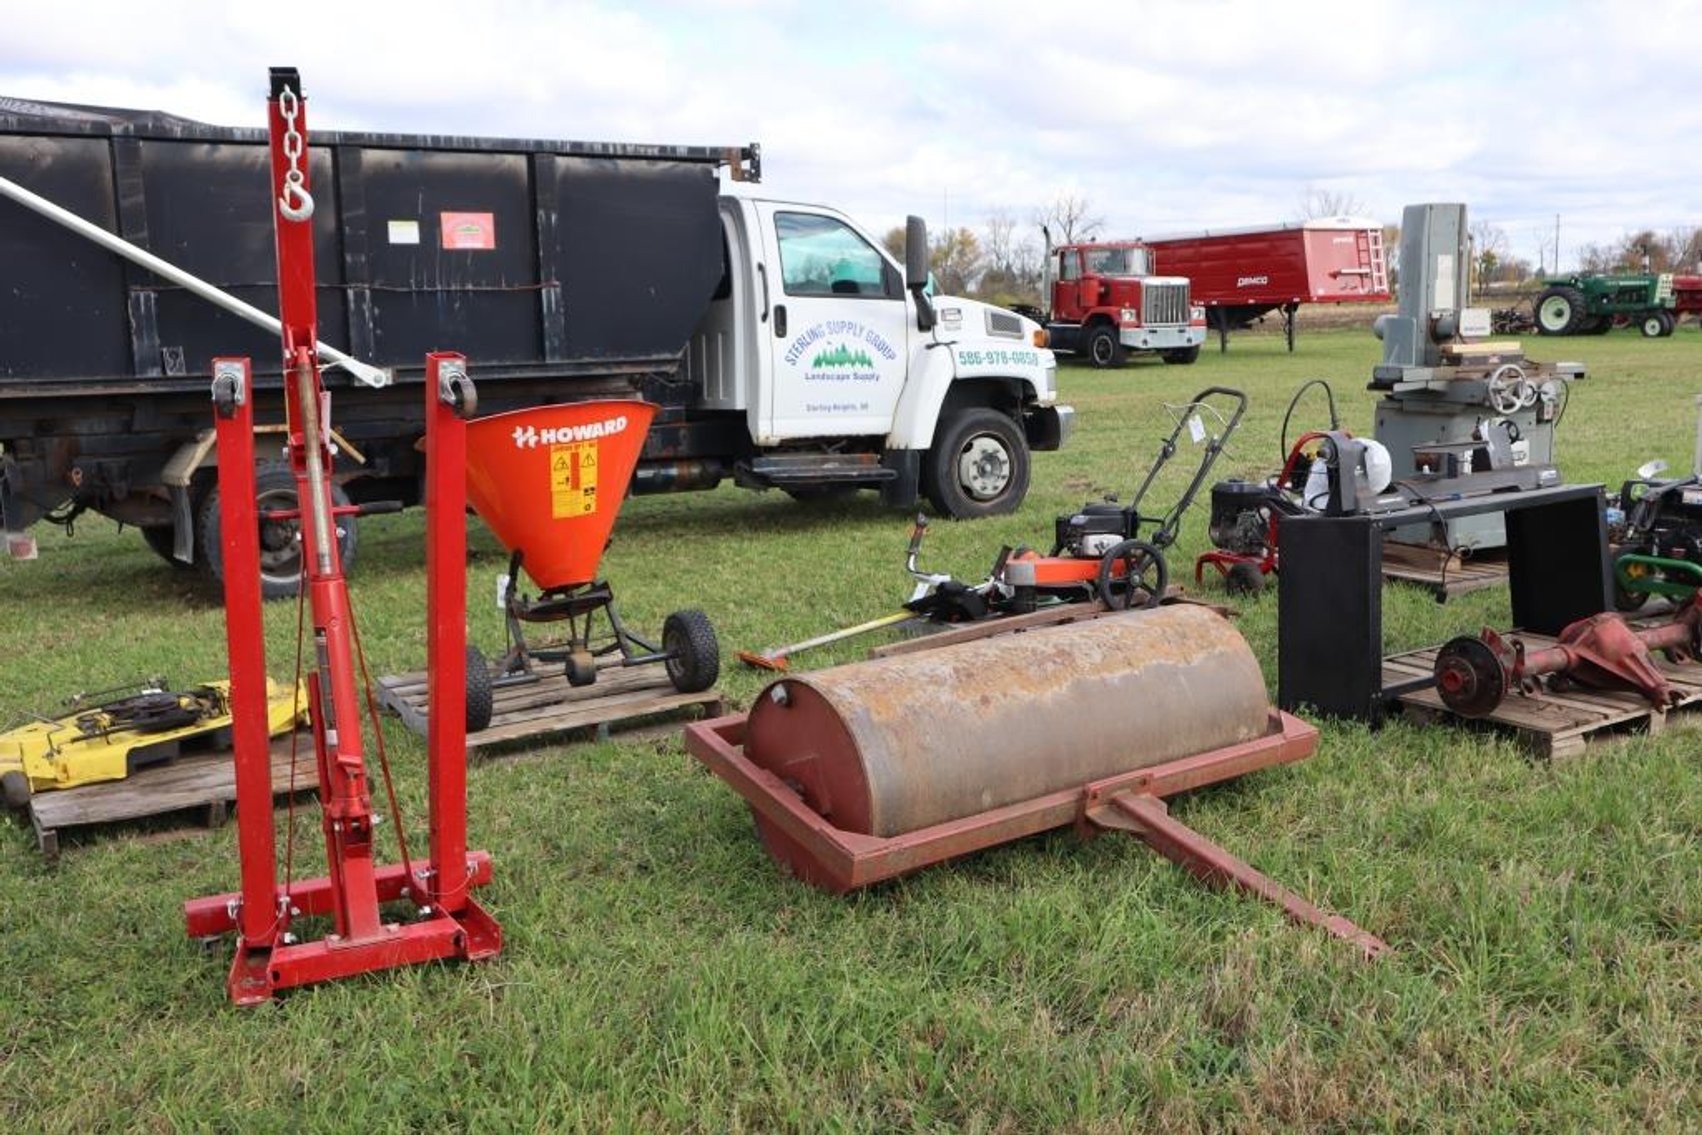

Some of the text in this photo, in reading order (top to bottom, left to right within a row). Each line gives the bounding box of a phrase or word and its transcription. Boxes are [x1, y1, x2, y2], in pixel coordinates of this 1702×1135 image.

[785, 320, 897, 366] STERLING SUPPLY GROUP
[805, 372, 880, 382] Landscape Supply
[541, 416, 627, 444] HOWARD
